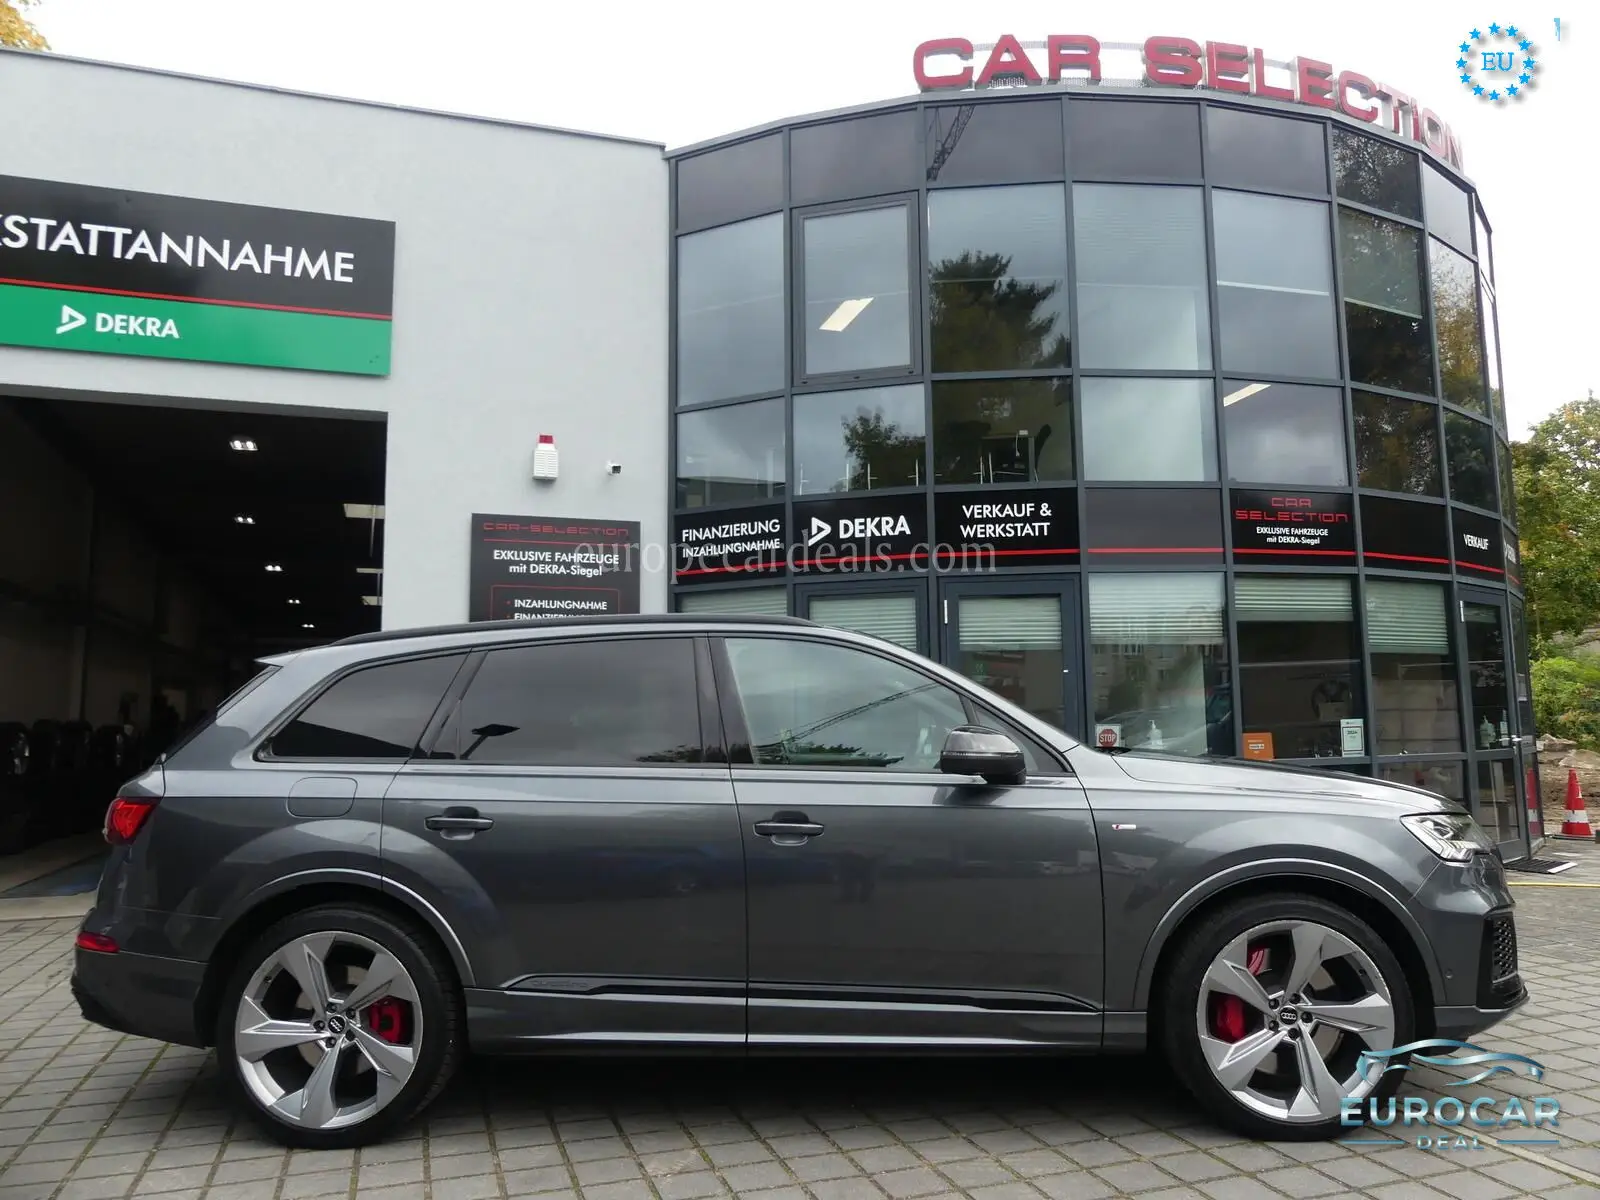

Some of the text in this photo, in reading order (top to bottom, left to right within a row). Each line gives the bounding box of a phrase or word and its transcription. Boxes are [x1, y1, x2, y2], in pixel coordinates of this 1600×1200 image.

[913, 34, 1465, 173] CAR SELECTION
[0, 213, 355, 284] STATTANNAHME
[95, 311, 181, 340] DEKRA
[962, 502, 1052, 519] VERKAUF &
[1271, 497, 1312, 508] CAR
[1235, 510, 1348, 523] SELECTION
[682, 519, 781, 543] FINANZIERUNG
[839, 515, 911, 540] DEKRA
[960, 522, 1051, 539] WERKSTATT
[1256, 526, 1329, 537] EXKLUSIVE FAHRZEUGE
[682, 538, 781, 559] INZAHLUNGNAHME
[1278, 536, 1321, 546] DEKRA-Siegel
[1463, 533, 1489, 551] VERKAUF
[493, 549, 620, 566] EXKLUSIVE FAHRZEUGE
[509, 563, 603, 579] mit DEKRA-Siegel
[514, 598, 608, 611] INZAHLUNGNAHME
[1099, 733, 1117, 743] STOP
